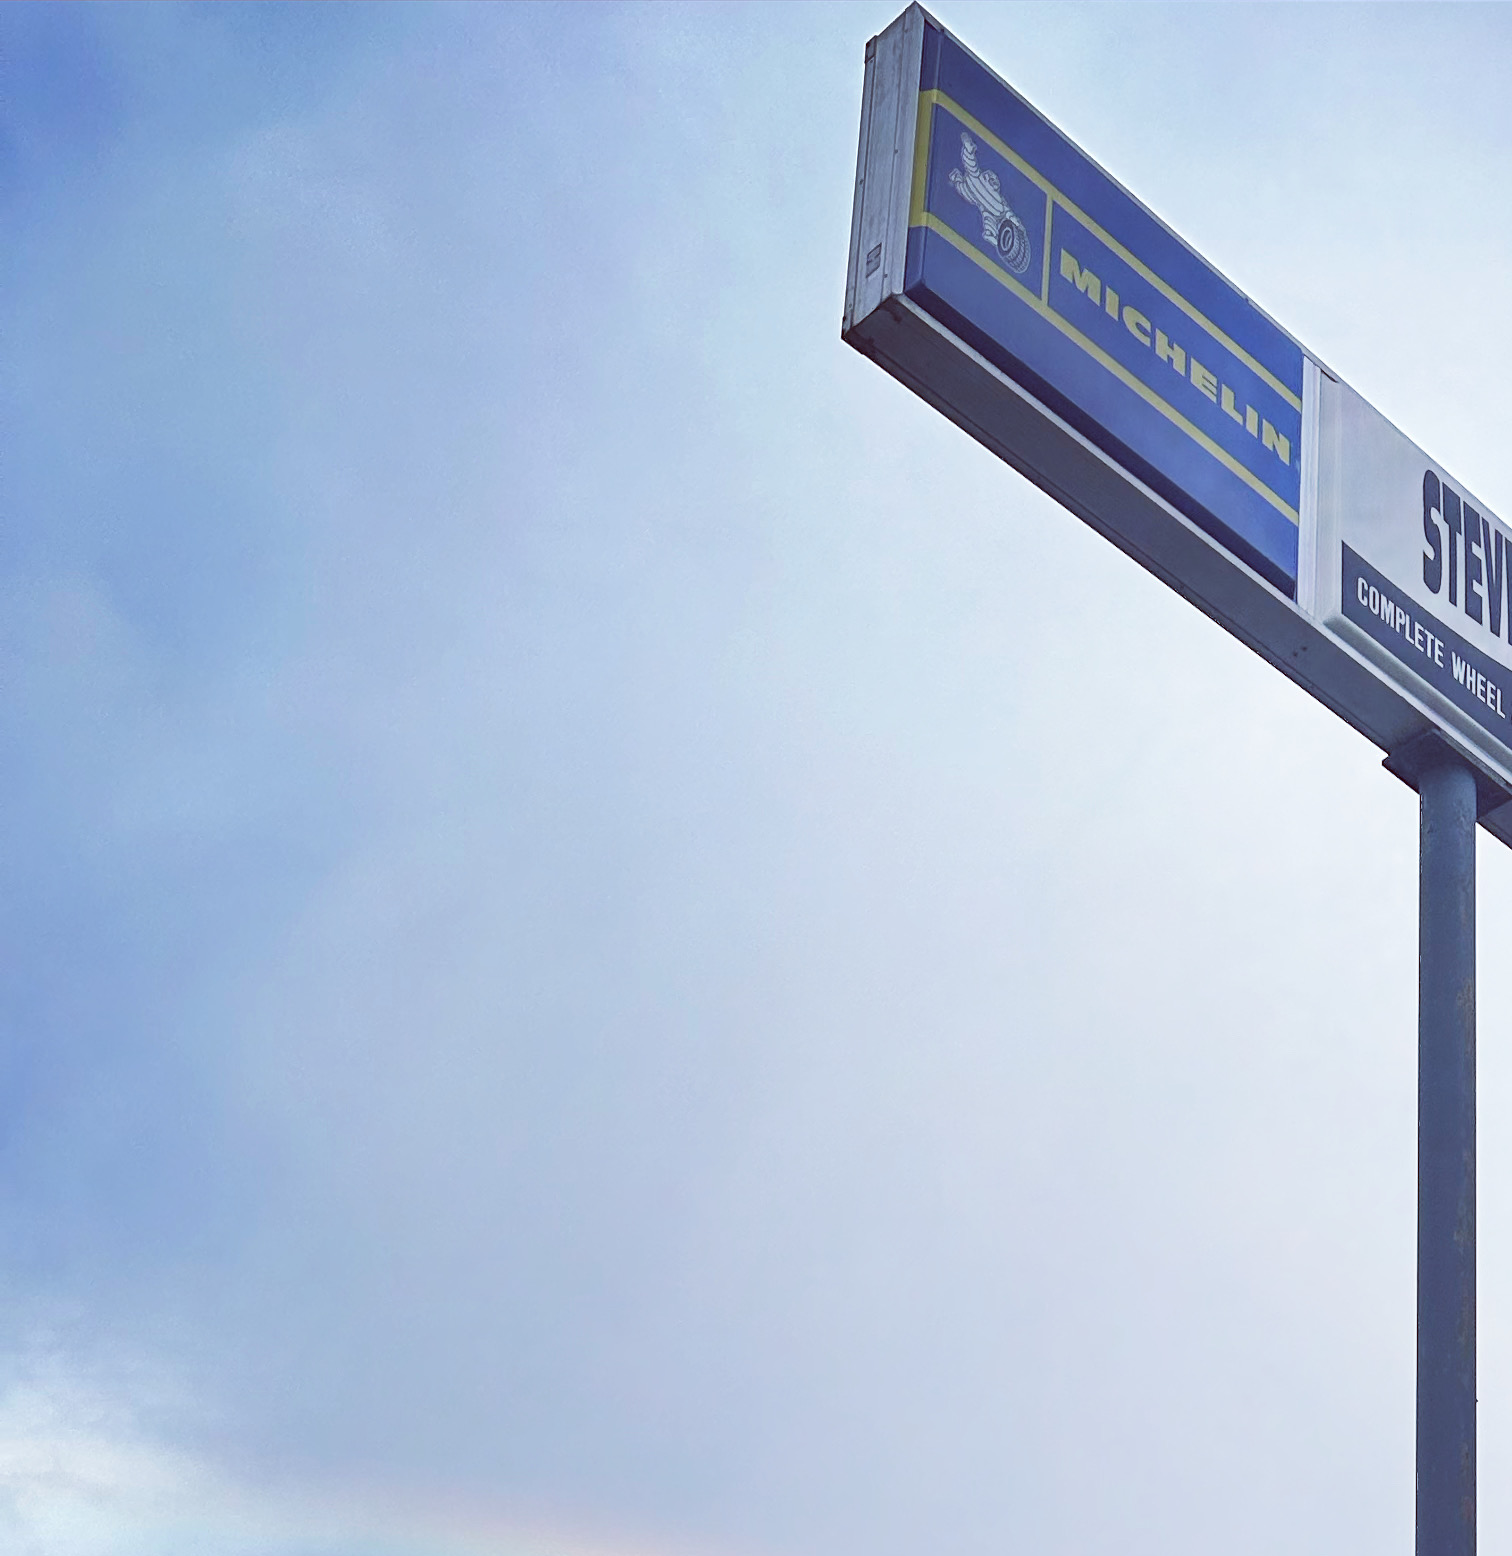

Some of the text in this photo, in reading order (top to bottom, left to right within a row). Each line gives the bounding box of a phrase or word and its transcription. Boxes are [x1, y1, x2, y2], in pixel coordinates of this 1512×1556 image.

[1060, 248, 1291, 466] MICHELIN
[1357, 576, 1445, 668] COMPLETE
[1452, 653, 1506, 718] WHEEL
